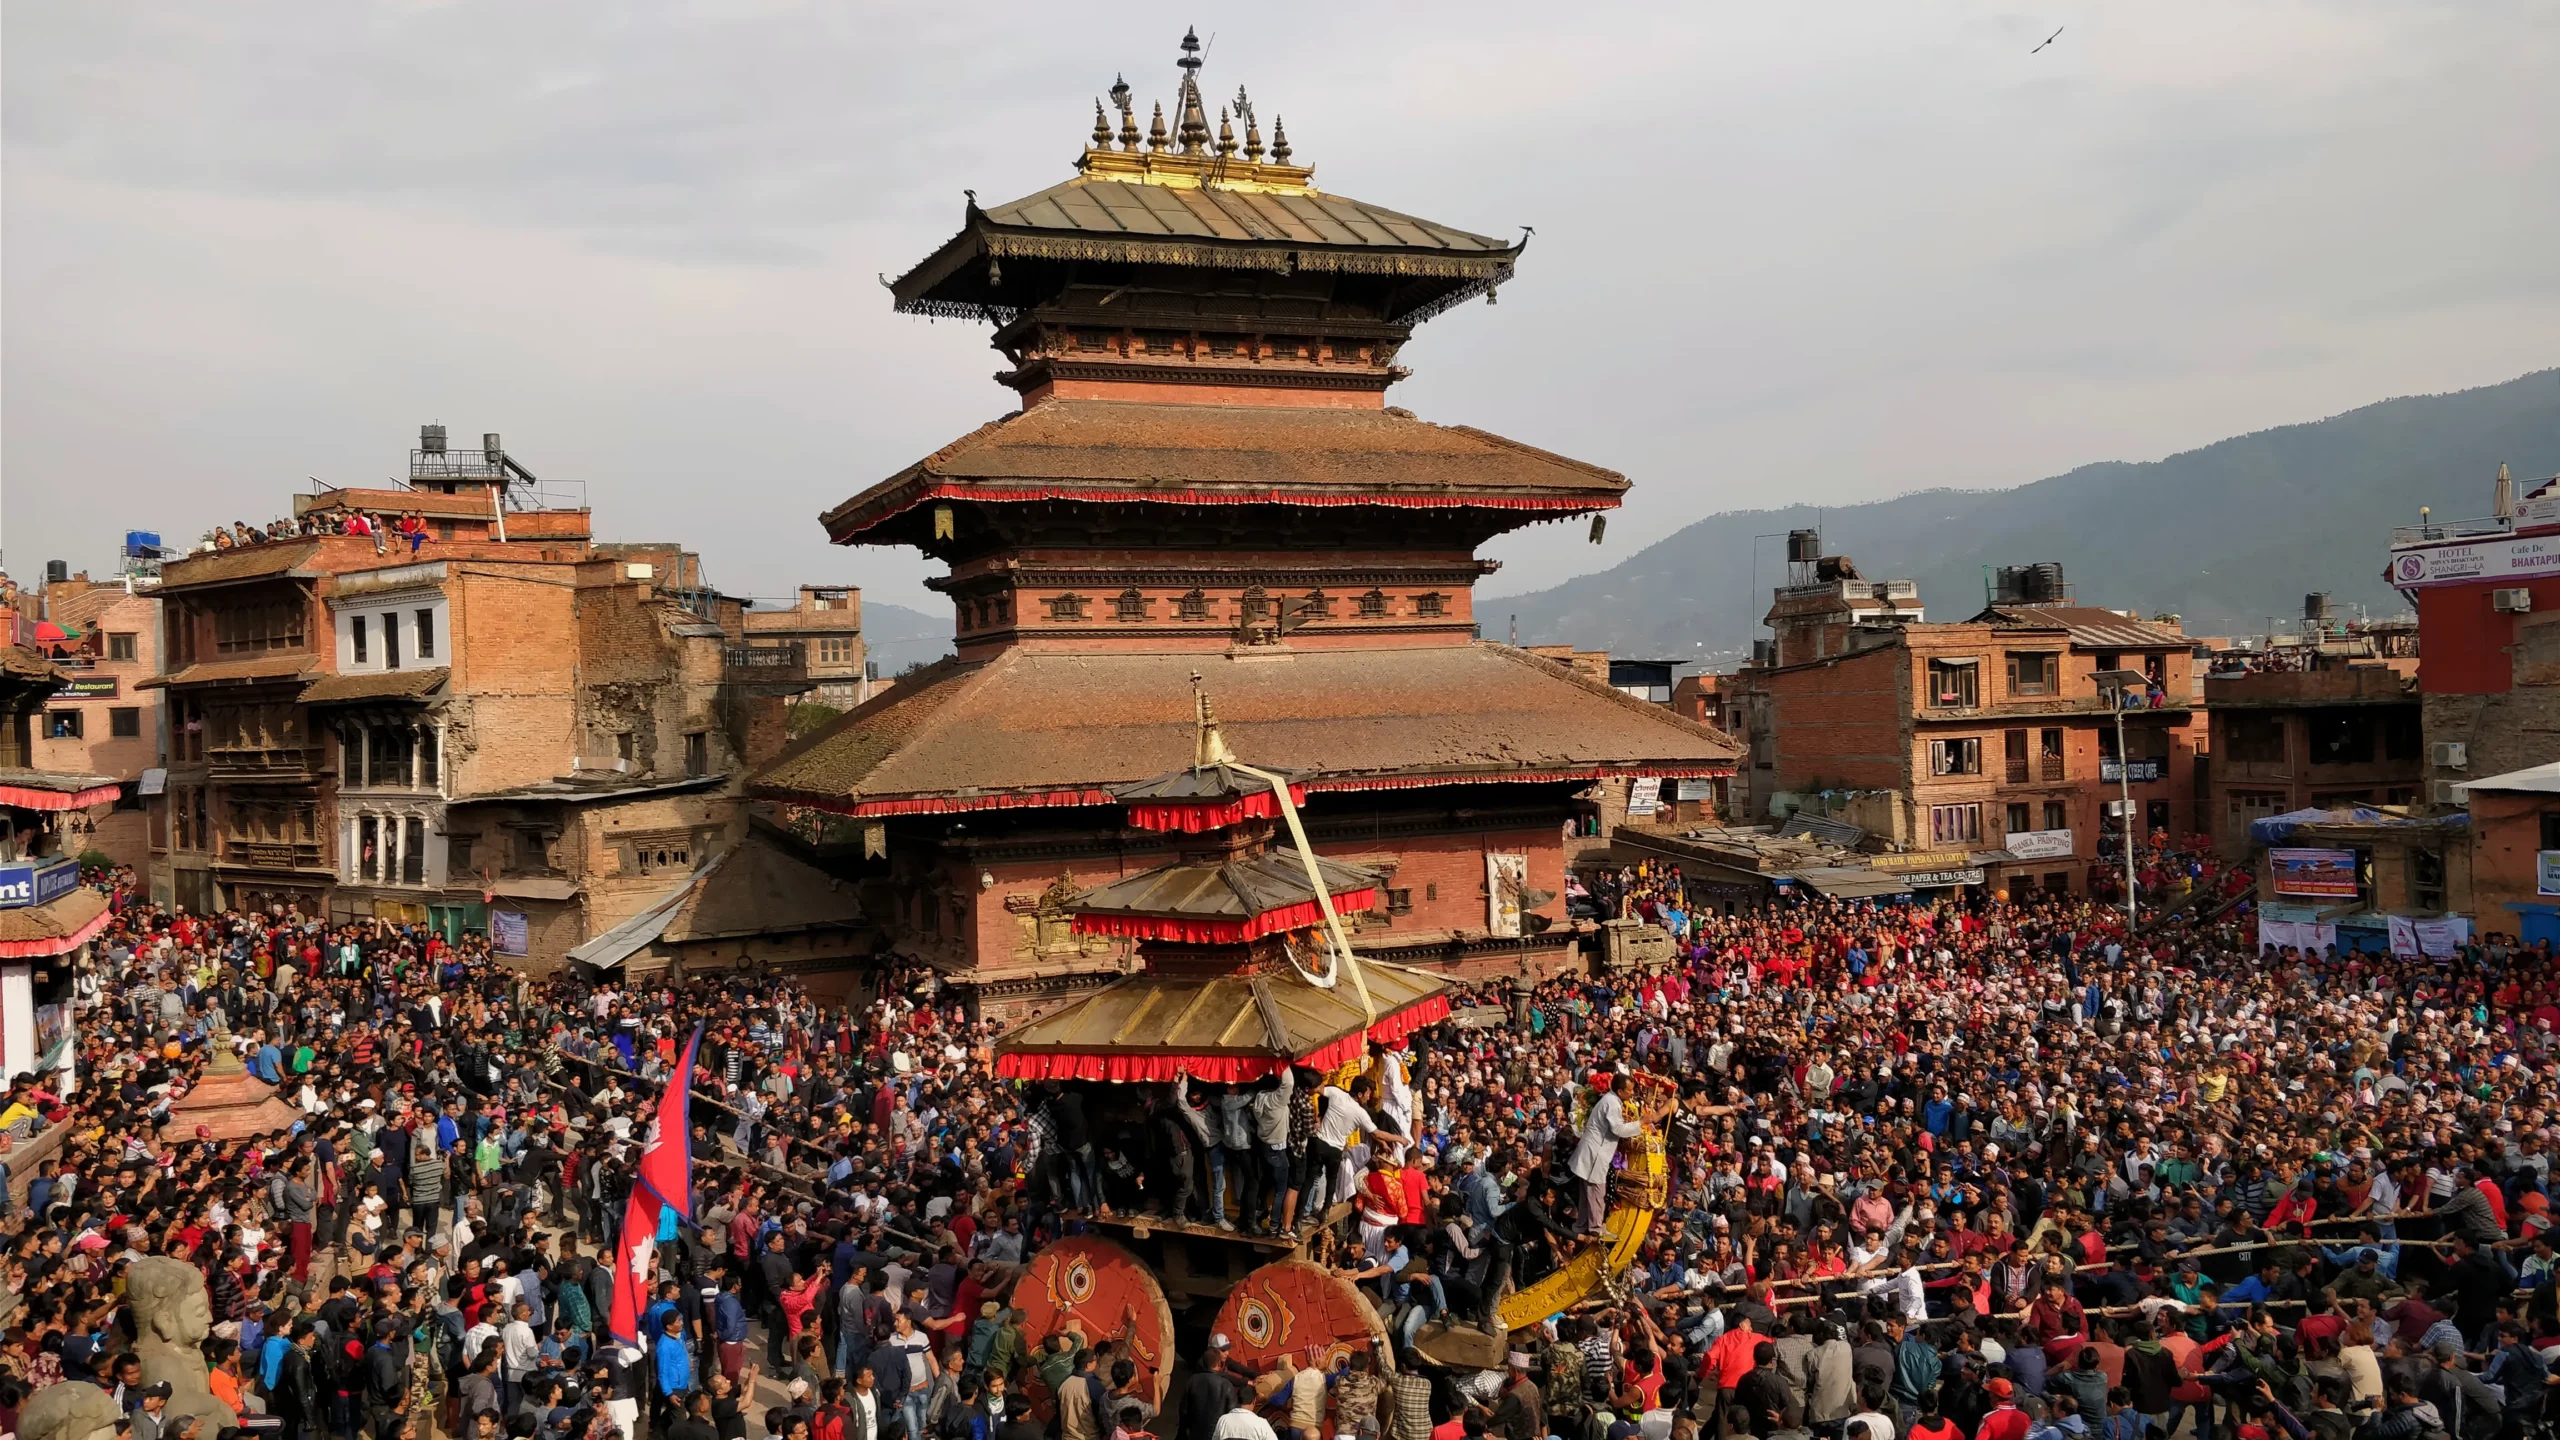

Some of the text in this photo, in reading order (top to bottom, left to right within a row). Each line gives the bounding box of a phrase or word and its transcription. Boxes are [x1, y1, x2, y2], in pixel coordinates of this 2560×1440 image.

[2438, 547, 2474, 559] HOTEL
[2511, 545, 2530, 554] Cafe
[2008, 835, 2070, 854] THANKA PAINTING
[1871, 856, 1888, 867] HAND
[1888, 856, 1905, 865] MADE
[1907, 854, 1926, 864] PAPER
[1932, 853, 1944, 863] TEA
[1911, 873, 1933, 882] PAPER
[1932, 872, 1939, 881] &
[1939, 872, 1953, 881] TEA
[1953, 869, 1981, 880] CENTRE
